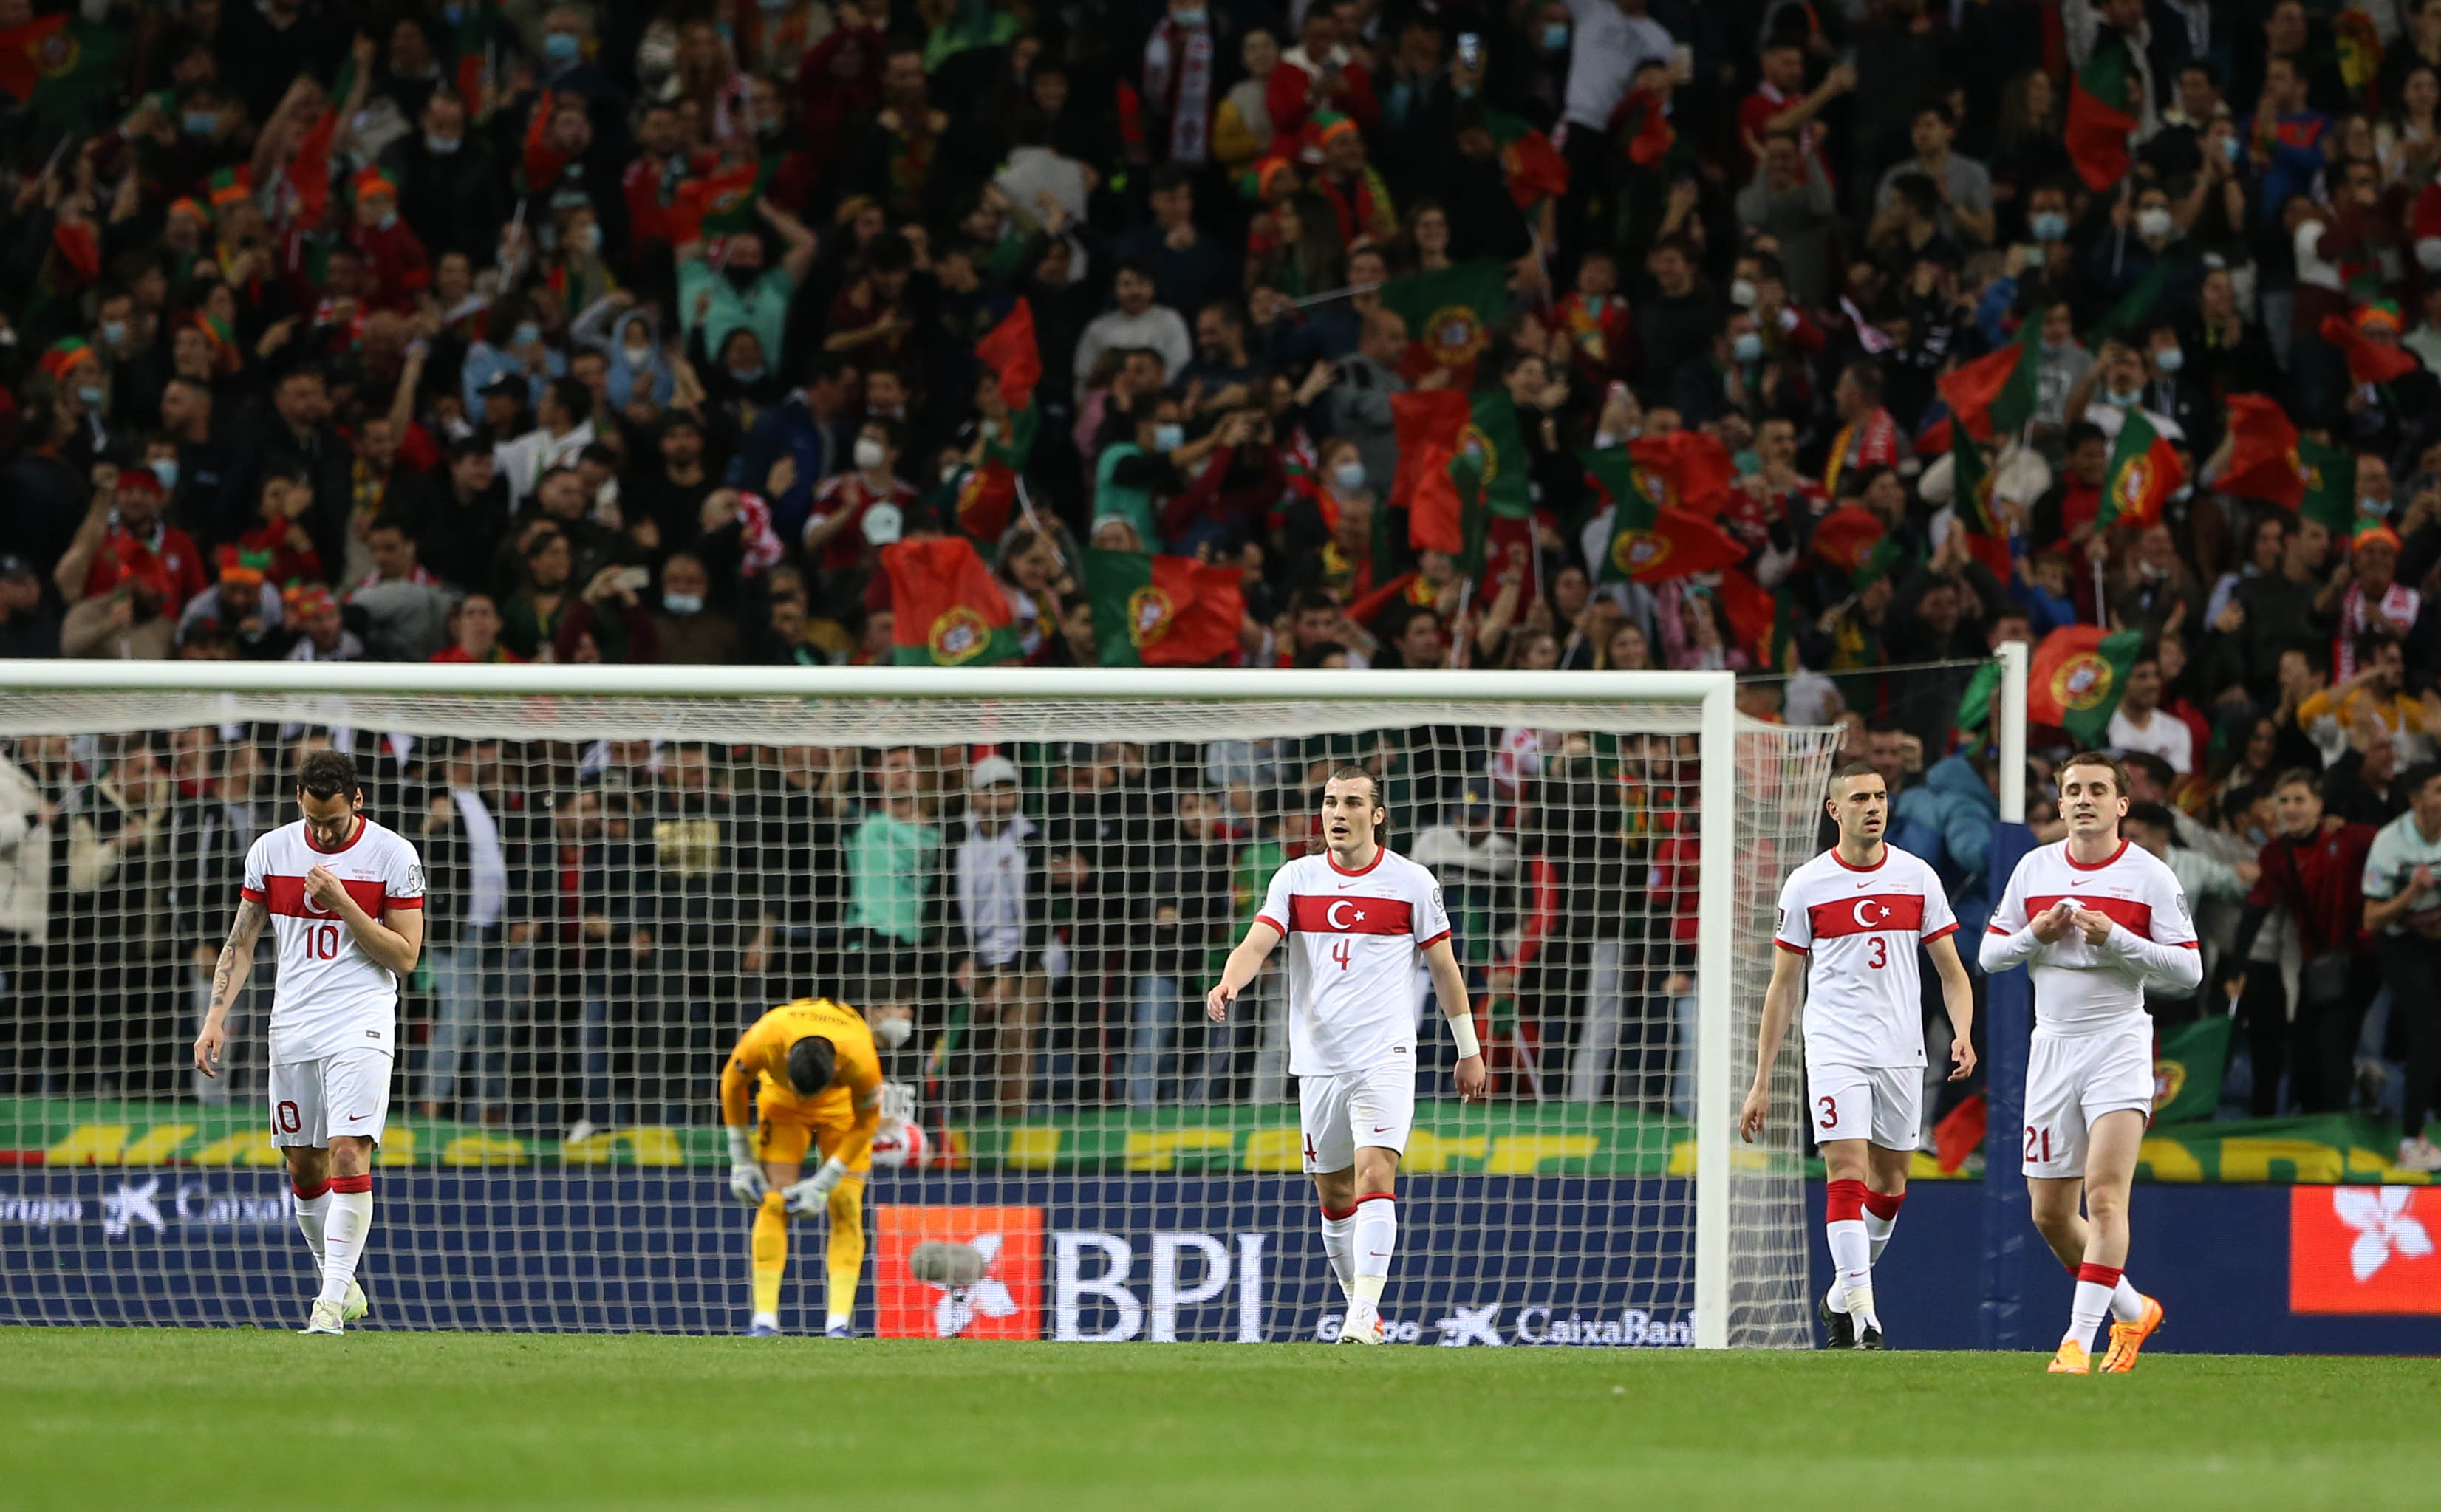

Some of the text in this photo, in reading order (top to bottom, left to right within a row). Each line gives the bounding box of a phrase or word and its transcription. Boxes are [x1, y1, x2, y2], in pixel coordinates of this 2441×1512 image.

[306, 925, 339, 960] 10
[1332, 938, 1352, 971] 4
[1867, 937, 1887, 969] 3
[1818, 1096, 1838, 1129] 3
[1302, 1132, 1318, 1163] 4
[2024, 1126, 2050, 1163] 21
[0, 1191, 83, 1231] rupo
[1053, 1231, 1268, 1343] BPI
[1317, 1314, 1420, 1343] Gpo
